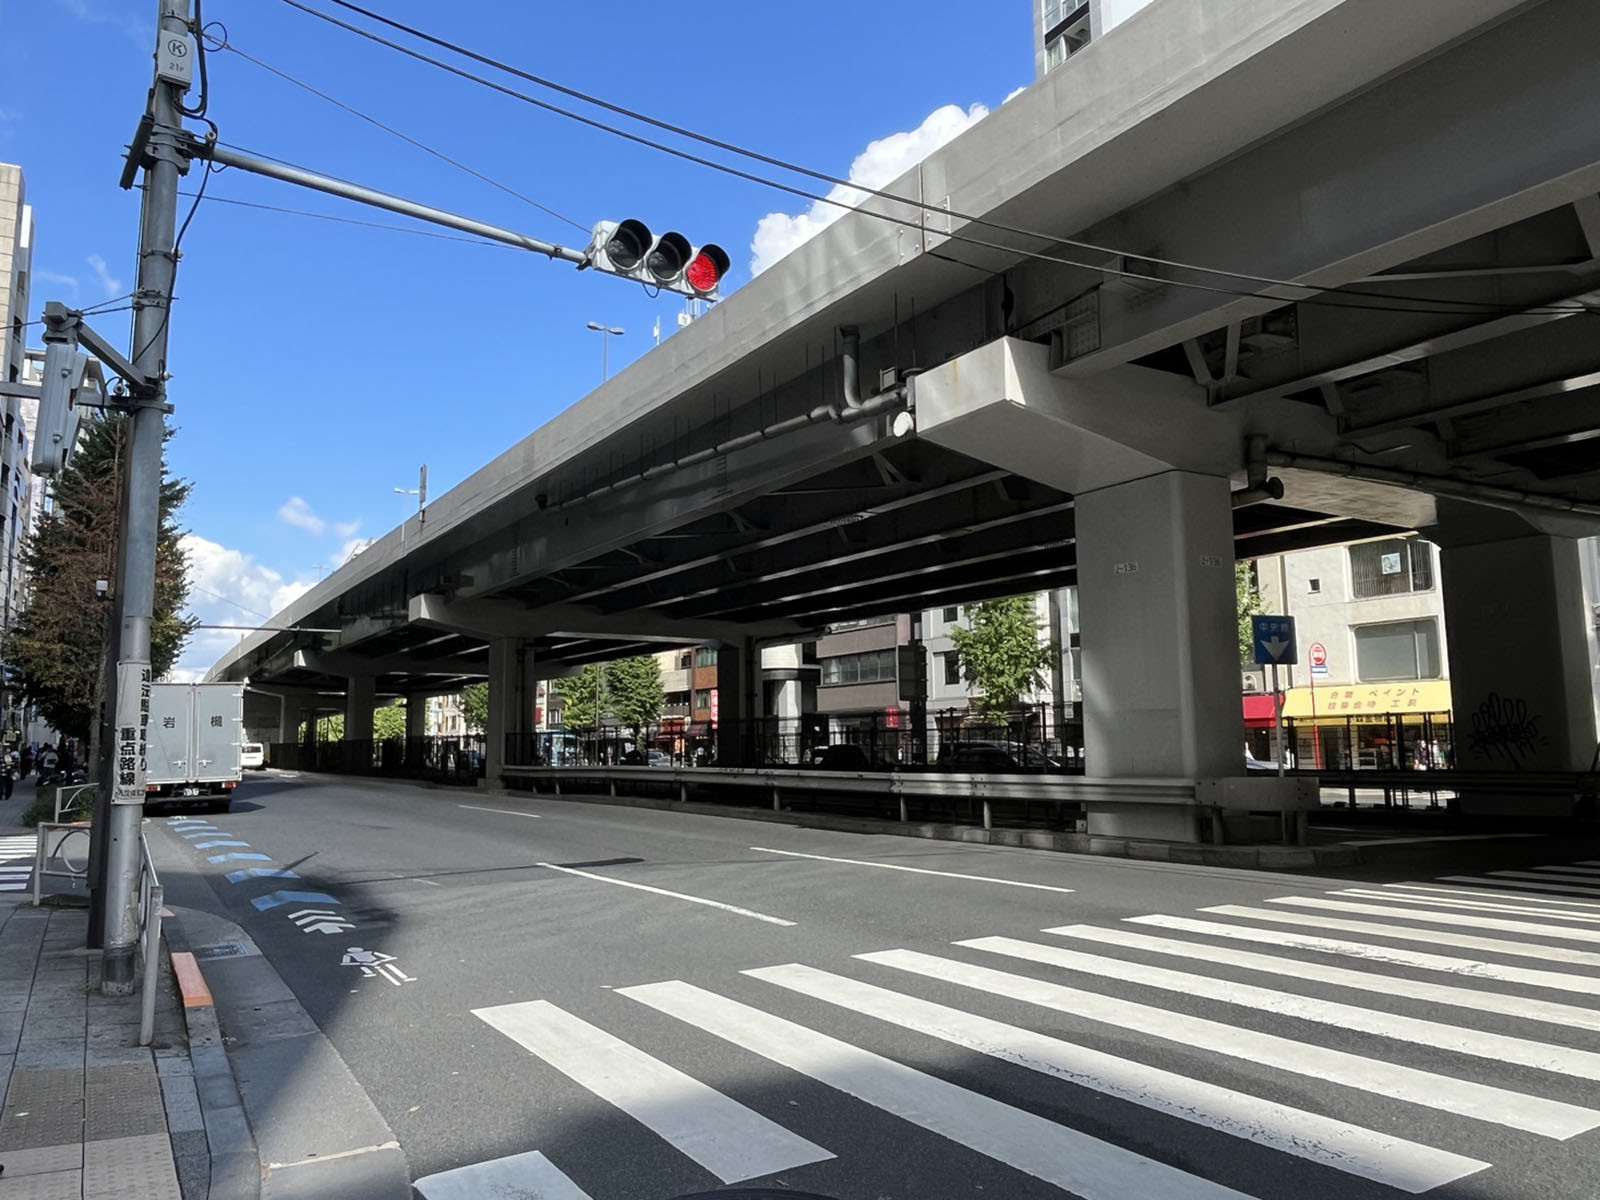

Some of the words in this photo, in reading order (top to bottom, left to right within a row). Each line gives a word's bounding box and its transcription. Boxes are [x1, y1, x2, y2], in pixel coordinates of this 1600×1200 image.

[1369, 687, 1420, 697] ペイント
[119, 727, 136, 786] 重点路線
